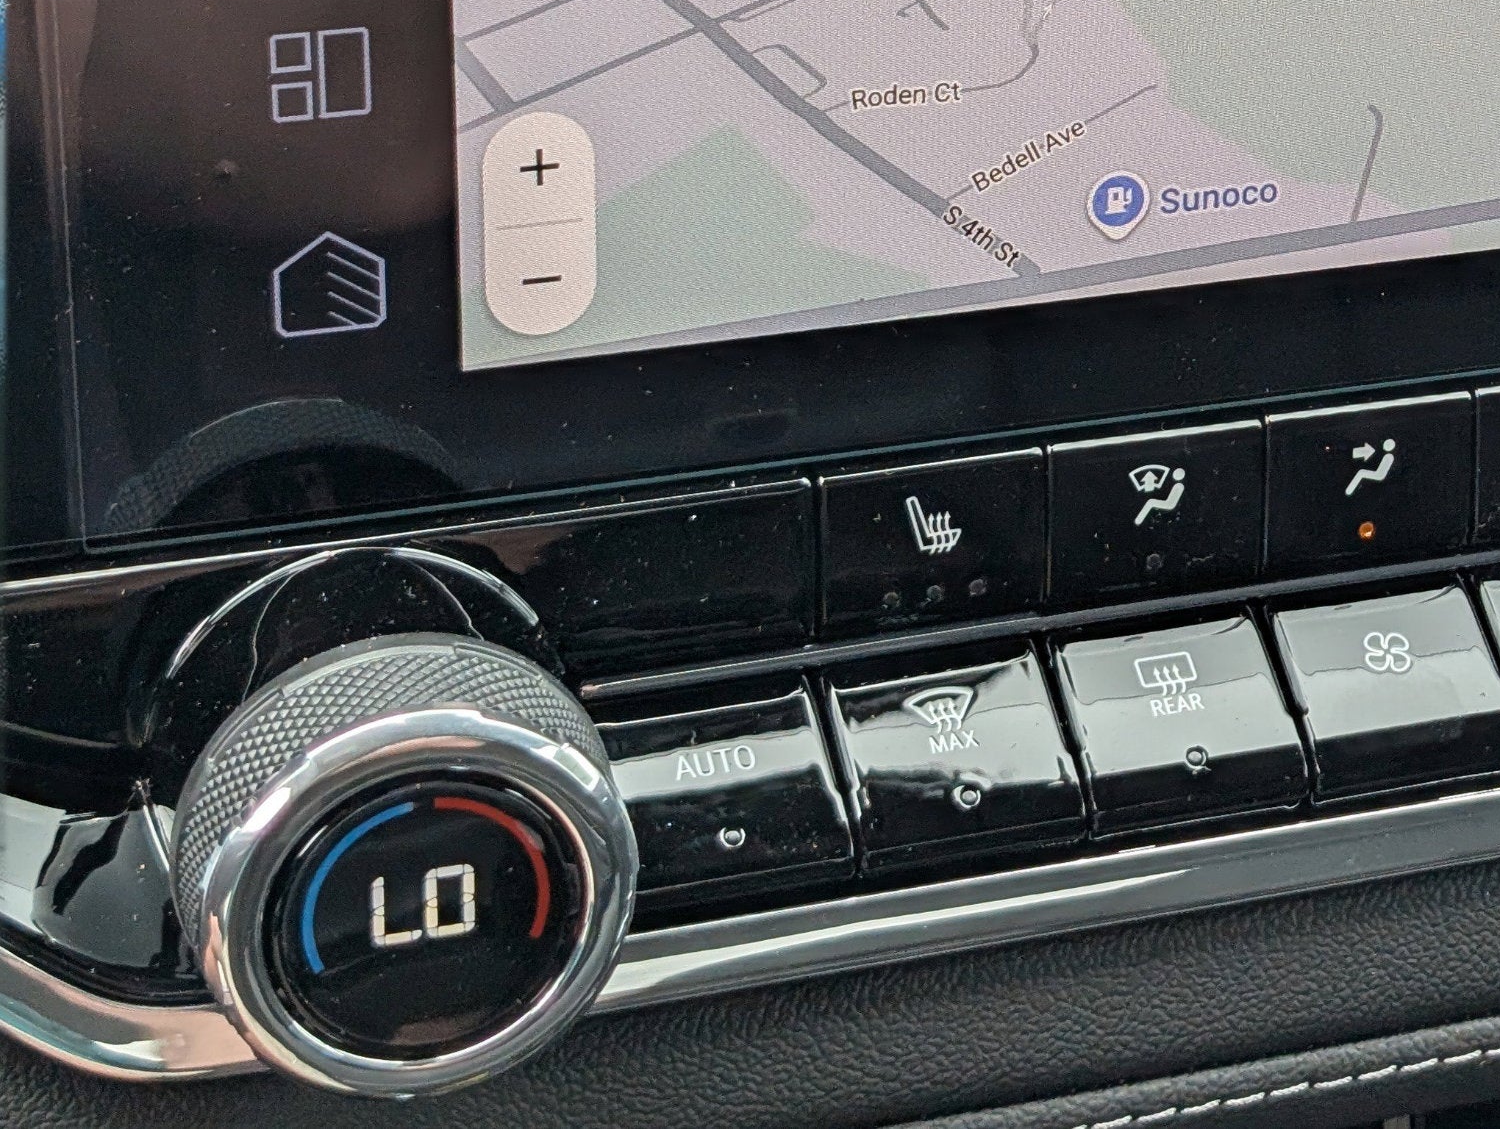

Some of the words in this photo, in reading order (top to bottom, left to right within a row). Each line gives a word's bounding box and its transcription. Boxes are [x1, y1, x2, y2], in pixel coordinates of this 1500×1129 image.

[851, 85, 927, 111] Roden
[934, 82, 961, 102] Ct
[971, 140, 1044, 193] Bedell
[1044, 120, 1087, 153] Ave
[1160, 182, 1278, 214] Sunoco
[943, 205, 962, 227] S
[960, 217, 994, 252] 4th
[994, 239, 1021, 268] St
[1149, 692, 1205, 717] REAR
[928, 729, 979, 755] MAX
[675, 744, 757, 781] AUTO
[370, 863, 476, 948] LO
